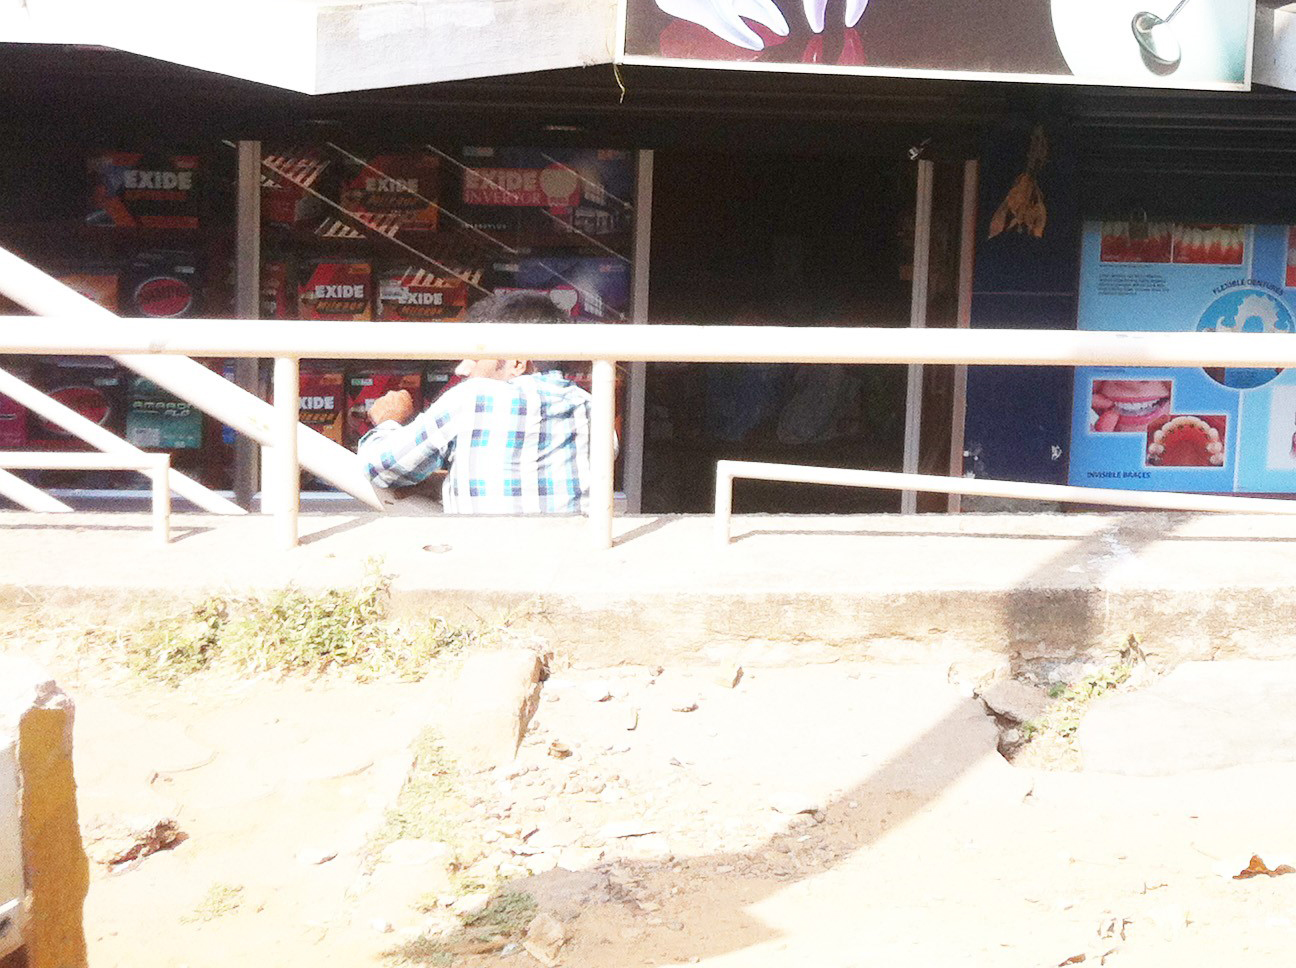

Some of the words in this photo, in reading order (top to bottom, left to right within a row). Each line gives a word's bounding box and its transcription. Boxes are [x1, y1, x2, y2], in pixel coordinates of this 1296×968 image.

[123, 169, 193, 190] EXIDE
[464, 169, 539, 191] EXIDE
[315, 284, 364, 299] EXIDE
[398, 293, 443, 306] EXIDE
[132, 401, 193, 410] AMARO
[299, 396, 335, 410] XIDE
[1087, 471, 1122, 479] INVISIBLE
[1123, 471, 1151, 479] BRACES
